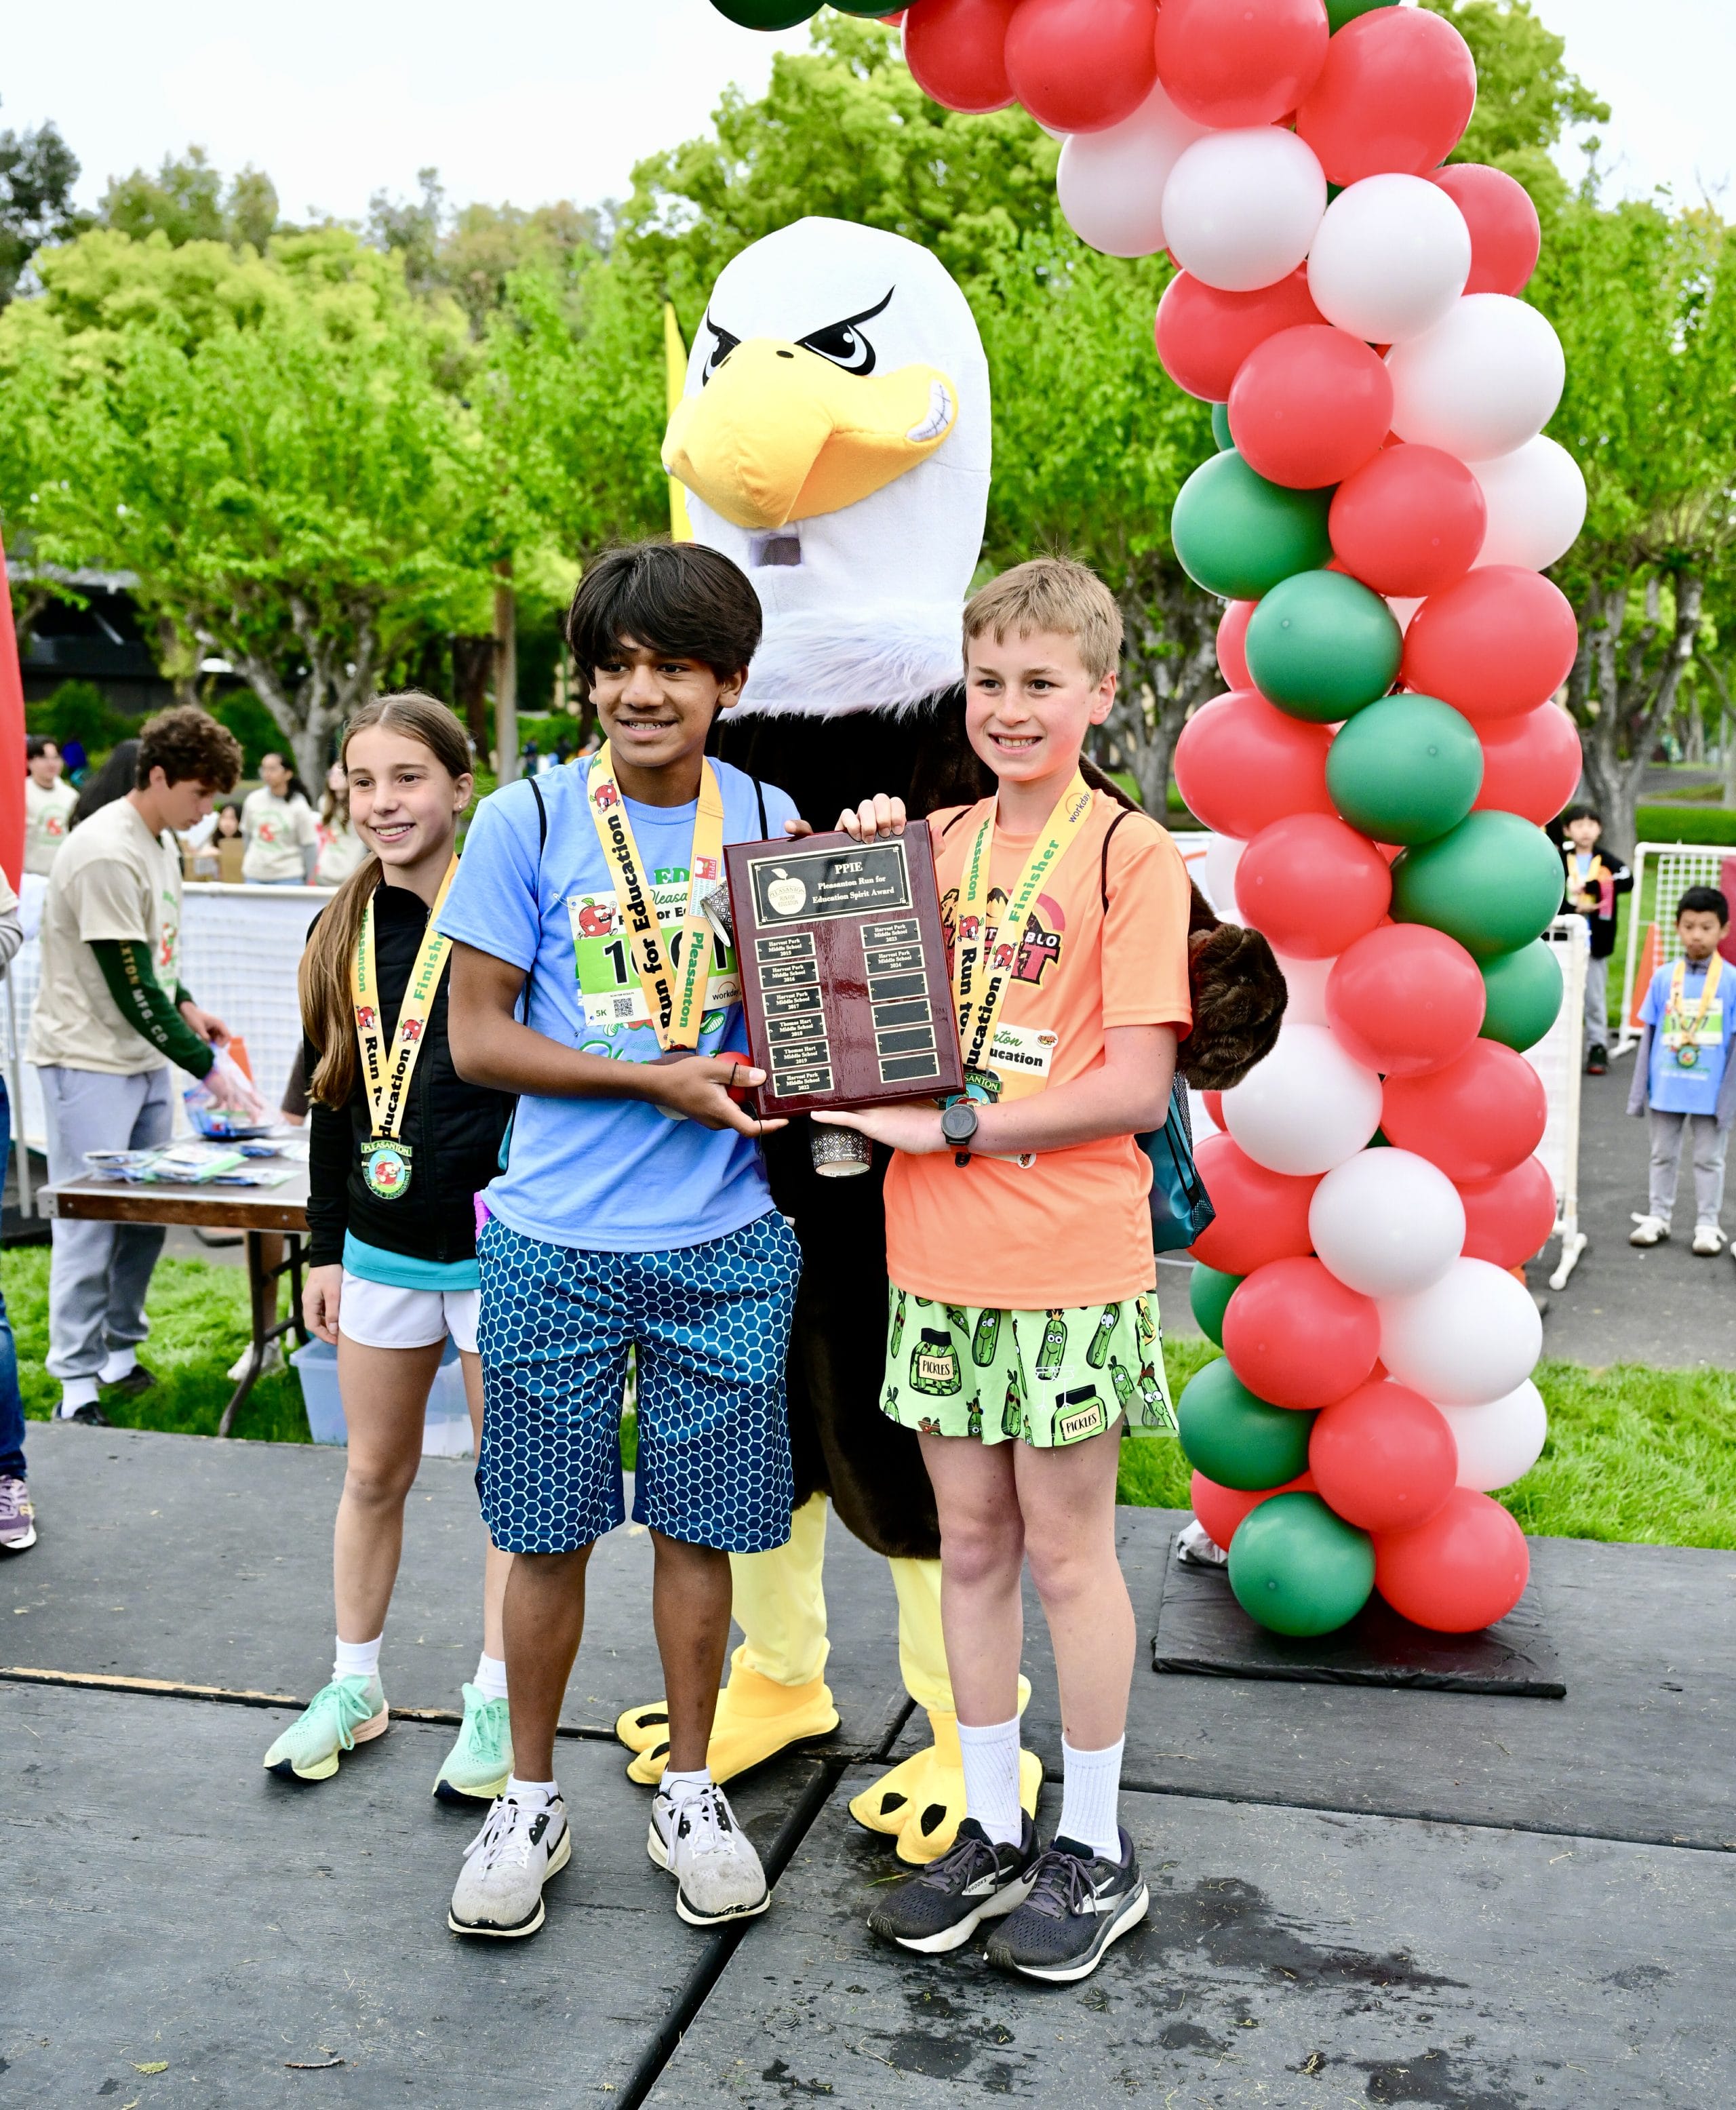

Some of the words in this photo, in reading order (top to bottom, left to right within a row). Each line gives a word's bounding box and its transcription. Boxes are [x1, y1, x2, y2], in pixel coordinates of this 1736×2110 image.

[1069, 791, 1091, 823] workday
[608, 814, 651, 932] Education
[834, 862, 863, 874] PPIE
[818, 879, 857, 890] Pleasanton
[858, 877, 873, 885] Run
[1008, 839, 1059, 922] Finisher
[769, 886, 805, 899] PLEASANTON
[812, 893, 849, 904] Education
[850, 890, 870, 900] Spirit
[871, 887, 895, 896] Award
[643, 938, 662, 974] for
[679, 932, 704, 1028] Pleasanton
[960, 947, 977, 996] Run
[713, 989, 739, 1000] workday
[366, 1036, 379, 1080] Run
[990, 1048, 1043, 1067] ucation
[379, 1049, 411, 1136] ducation
[364, 1142, 409, 1155] PLEASANTON
[923, 1360, 950, 1375] PICKLES
[1066, 1413, 1097, 1434] PICKLES
[968, 1877, 987, 1893] BROOKS
